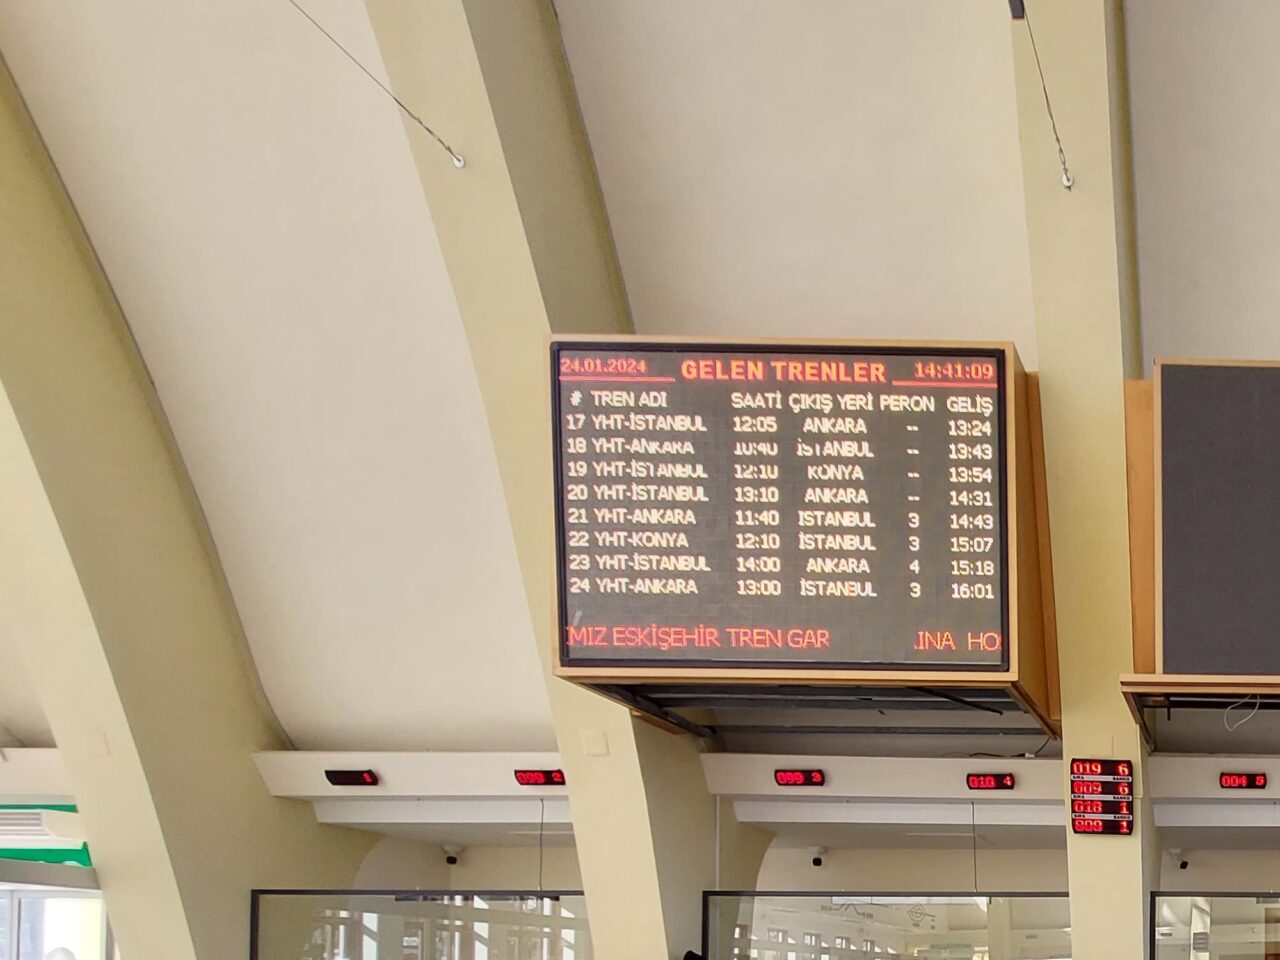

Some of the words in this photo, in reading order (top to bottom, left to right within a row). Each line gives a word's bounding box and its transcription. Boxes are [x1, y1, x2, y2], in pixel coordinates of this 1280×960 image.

[560, 358, 647, 373] 24.01.2024
[681, 359, 764, 381] GELEN
[770, 361, 886, 384] TRENLER
[914, 361, 994, 379] 14:41:09
[569, 390, 583, 407] #
[590, 390, 635, 407] TREN
[639, 391, 668, 408] ADI
[730, 390, 782, 409] SAATİ
[788, 393, 833, 414] ÇIKIŞ
[836, 391, 874, 411] YERİ
[879, 394, 935, 412] PERON
[946, 394, 993, 417] GELİŞ
[566, 413, 586, 430] 17
[591, 411, 708, 432] YHT-İSTANBUL
[733, 415, 778, 432] 12:05
[803, 417, 868, 434] ANKARA
[948, 420, 992, 437] 13:24
[567, 437, 587, 453] 18
[592, 437, 695, 455] YHT-ANKARA
[948, 443, 993, 460] 13:43
[567, 460, 587, 477] 19
[592, 459, 709, 478] YHT-İSTANBUL
[807, 464, 864, 480] KONYA
[949, 467, 992, 483] 13:54
[567, 484, 589, 501] 20
[593, 482, 709, 502] YHT-İSTANBUL
[734, 486, 779, 502] 13:10
[804, 487, 869, 504] ANKARA
[949, 490, 993, 507] 14:31
[568, 507, 590, 524] 21
[593, 508, 697, 525] YHT-ANKARA
[735, 510, 780, 526] 11:40
[907, 512, 920, 528] 3
[950, 513, 994, 529] 14:43
[568, 531, 590, 547] 22
[594, 531, 689, 548] YHT-KONYA
[735, 533, 780, 549] 12:10
[798, 531, 877, 550] İSTANBUL
[908, 535, 920, 552] 3
[950, 537, 994, 553] 15:07
[569, 554, 591, 570] 23
[594, 552, 711, 572] YHT-İSTANBUL
[736, 556, 781, 572] 14:00
[806, 557, 871, 574] ANKARA
[909, 559, 920, 575] 4
[951, 560, 995, 576] 15:18
[569, 577, 591, 593] 24
[595, 578, 699, 594] YHT-ANKARA
[737, 579, 782, 596] 13:00
[799, 578, 878, 597] İSTANBUL
[909, 582, 921, 598] 3
[951, 582, 995, 599] 16:01
[567, 626, 609, 646] MIZ
[612, 623, 722, 651] ESKİŞEHİR
[725, 628, 782, 648] TREN
[787, 628, 830, 648] GAR
[914, 631, 956, 650] INA
[967, 631, 1002, 651] HO
[1118, 763, 1129, 776] 6
[1120, 802, 1129, 814] 1
[1120, 821, 1129, 833] 1
